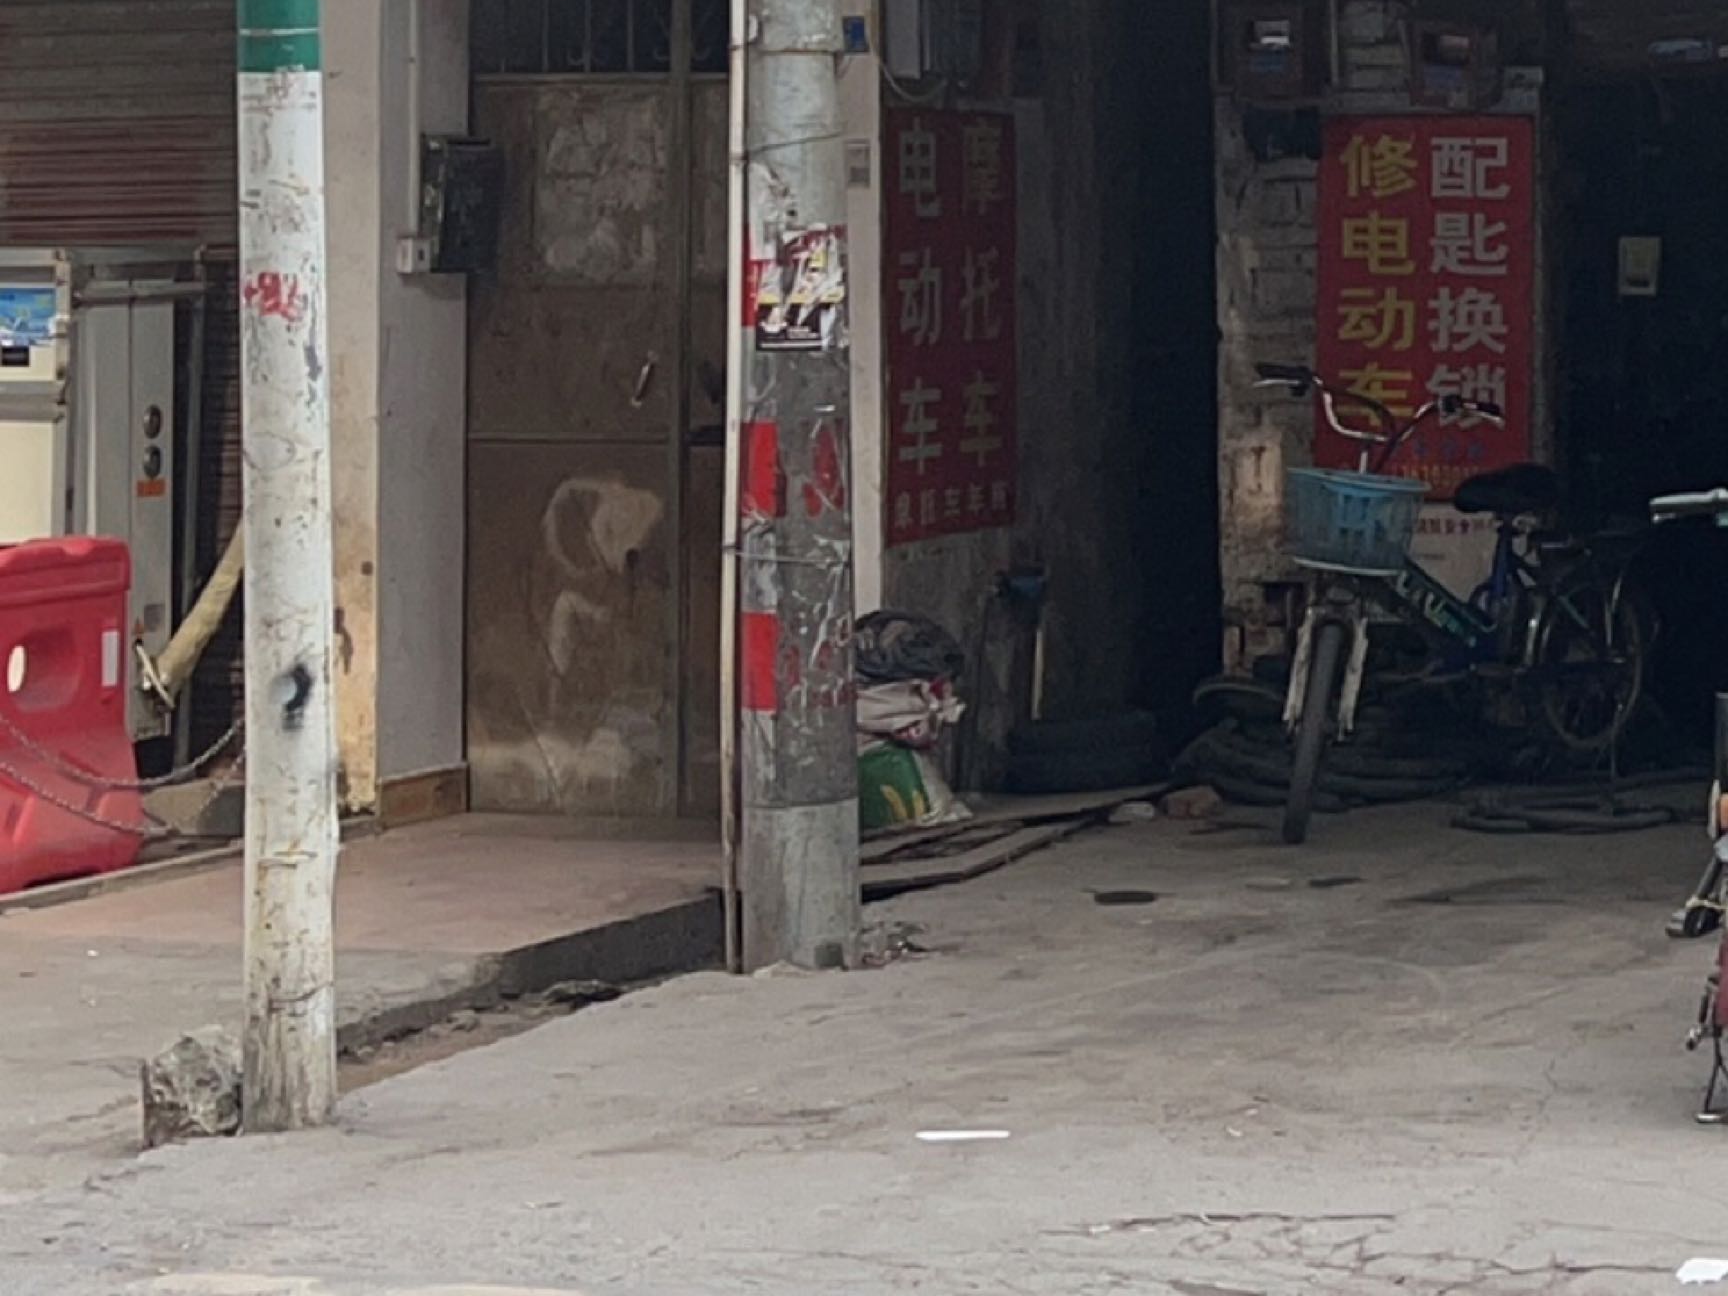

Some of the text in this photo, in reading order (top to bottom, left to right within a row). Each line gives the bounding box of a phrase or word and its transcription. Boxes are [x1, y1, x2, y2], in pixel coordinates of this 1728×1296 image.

[898, 117, 941, 476] 电动车
[959, 117, 1002, 469] 摩托车
[1336, 134, 1419, 428] 修电动车
[1425, 135, 1509, 430] 配匙换锁
